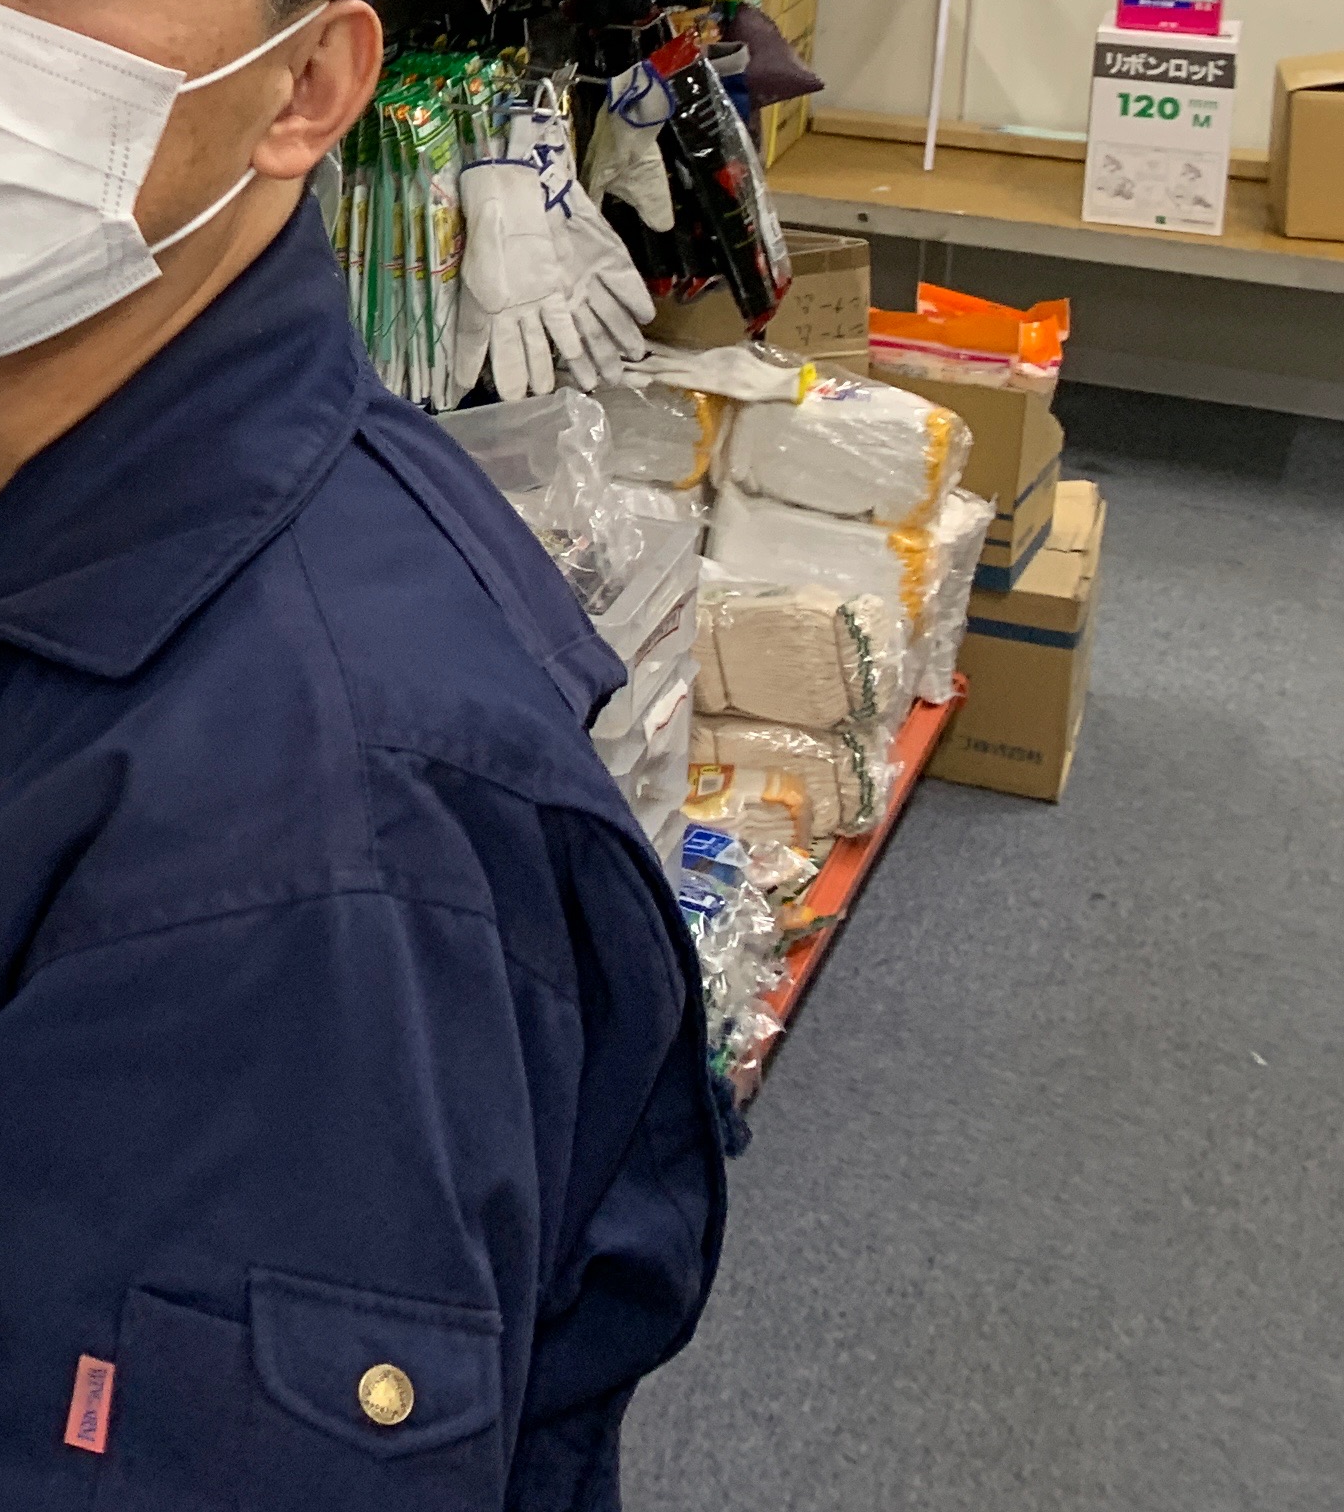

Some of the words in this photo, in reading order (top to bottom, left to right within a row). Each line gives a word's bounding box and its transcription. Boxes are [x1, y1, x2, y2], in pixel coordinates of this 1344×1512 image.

[1105, 51, 1228, 83] リボンロッド
[1116, 92, 1180, 120] 120
